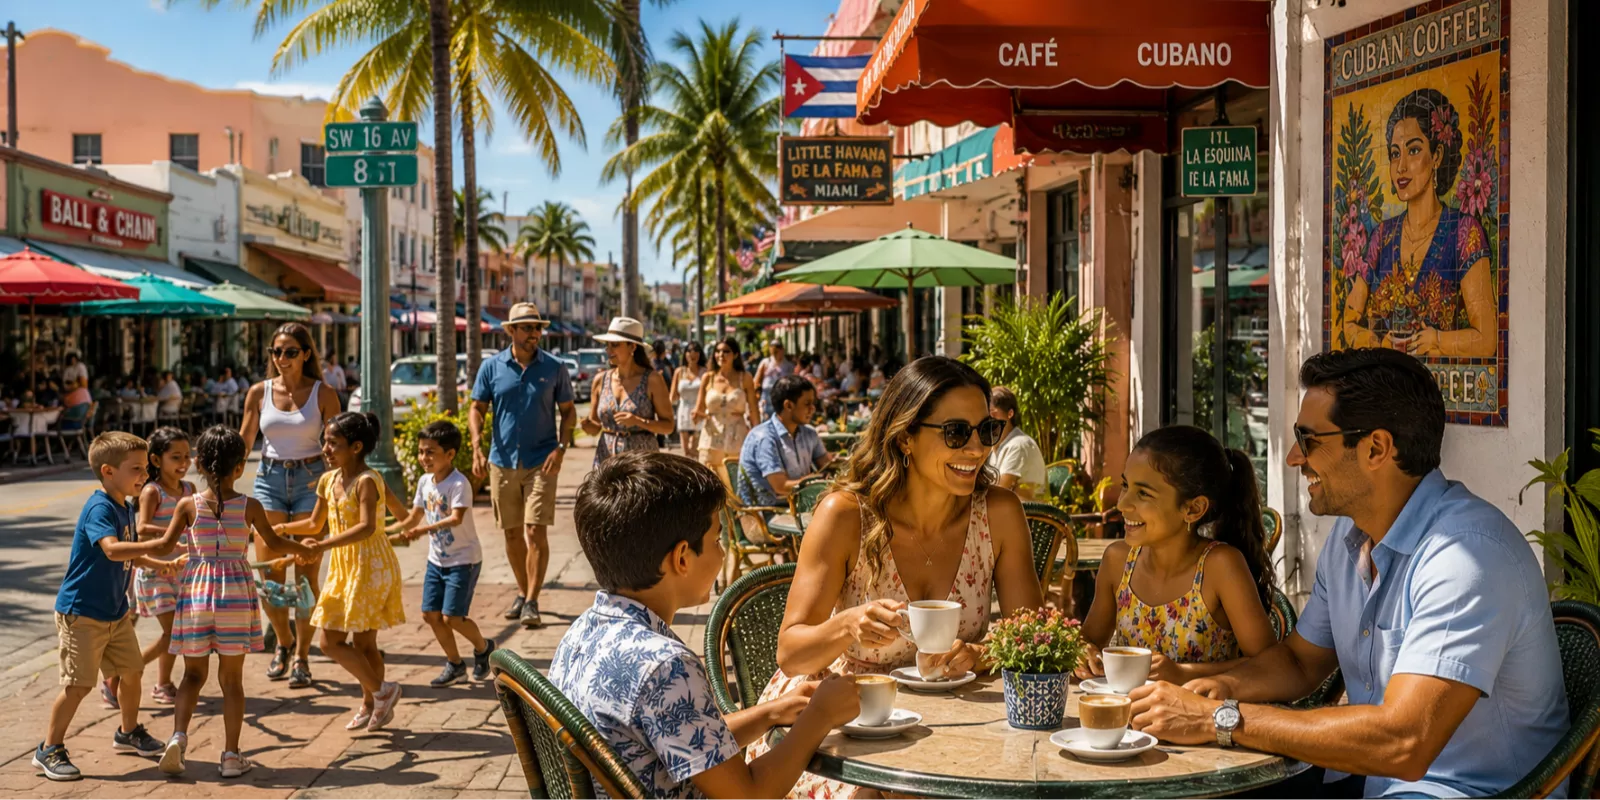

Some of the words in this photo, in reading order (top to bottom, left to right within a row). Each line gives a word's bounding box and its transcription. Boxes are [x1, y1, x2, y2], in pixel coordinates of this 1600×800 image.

[999, 37, 1058, 66] CAFÉ
[1137, 42, 1232, 66] CUBANO
[1341, 32, 1404, 80] CUBAN
[1413, 2, 1490, 57] COFFEE
[328, 128, 353, 149] SW
[363, 126, 381, 148] 16
[391, 128, 411, 147] AV
[788, 145, 832, 161] LITTLE
[835, 145, 886, 163] HAVANA
[1186, 148, 1201, 165] LA
[1204, 145, 1252, 165] ESQUINA
[353, 158, 368, 184] 8
[791, 163, 810, 178] DE
[813, 164, 831, 178] LA
[1203, 170, 1216, 187] LA
[814, 184, 858, 197] MIAMI
[51, 195, 92, 229] BALL
[97, 207, 108, 233] &
[115, 210, 155, 240] CHAIN
